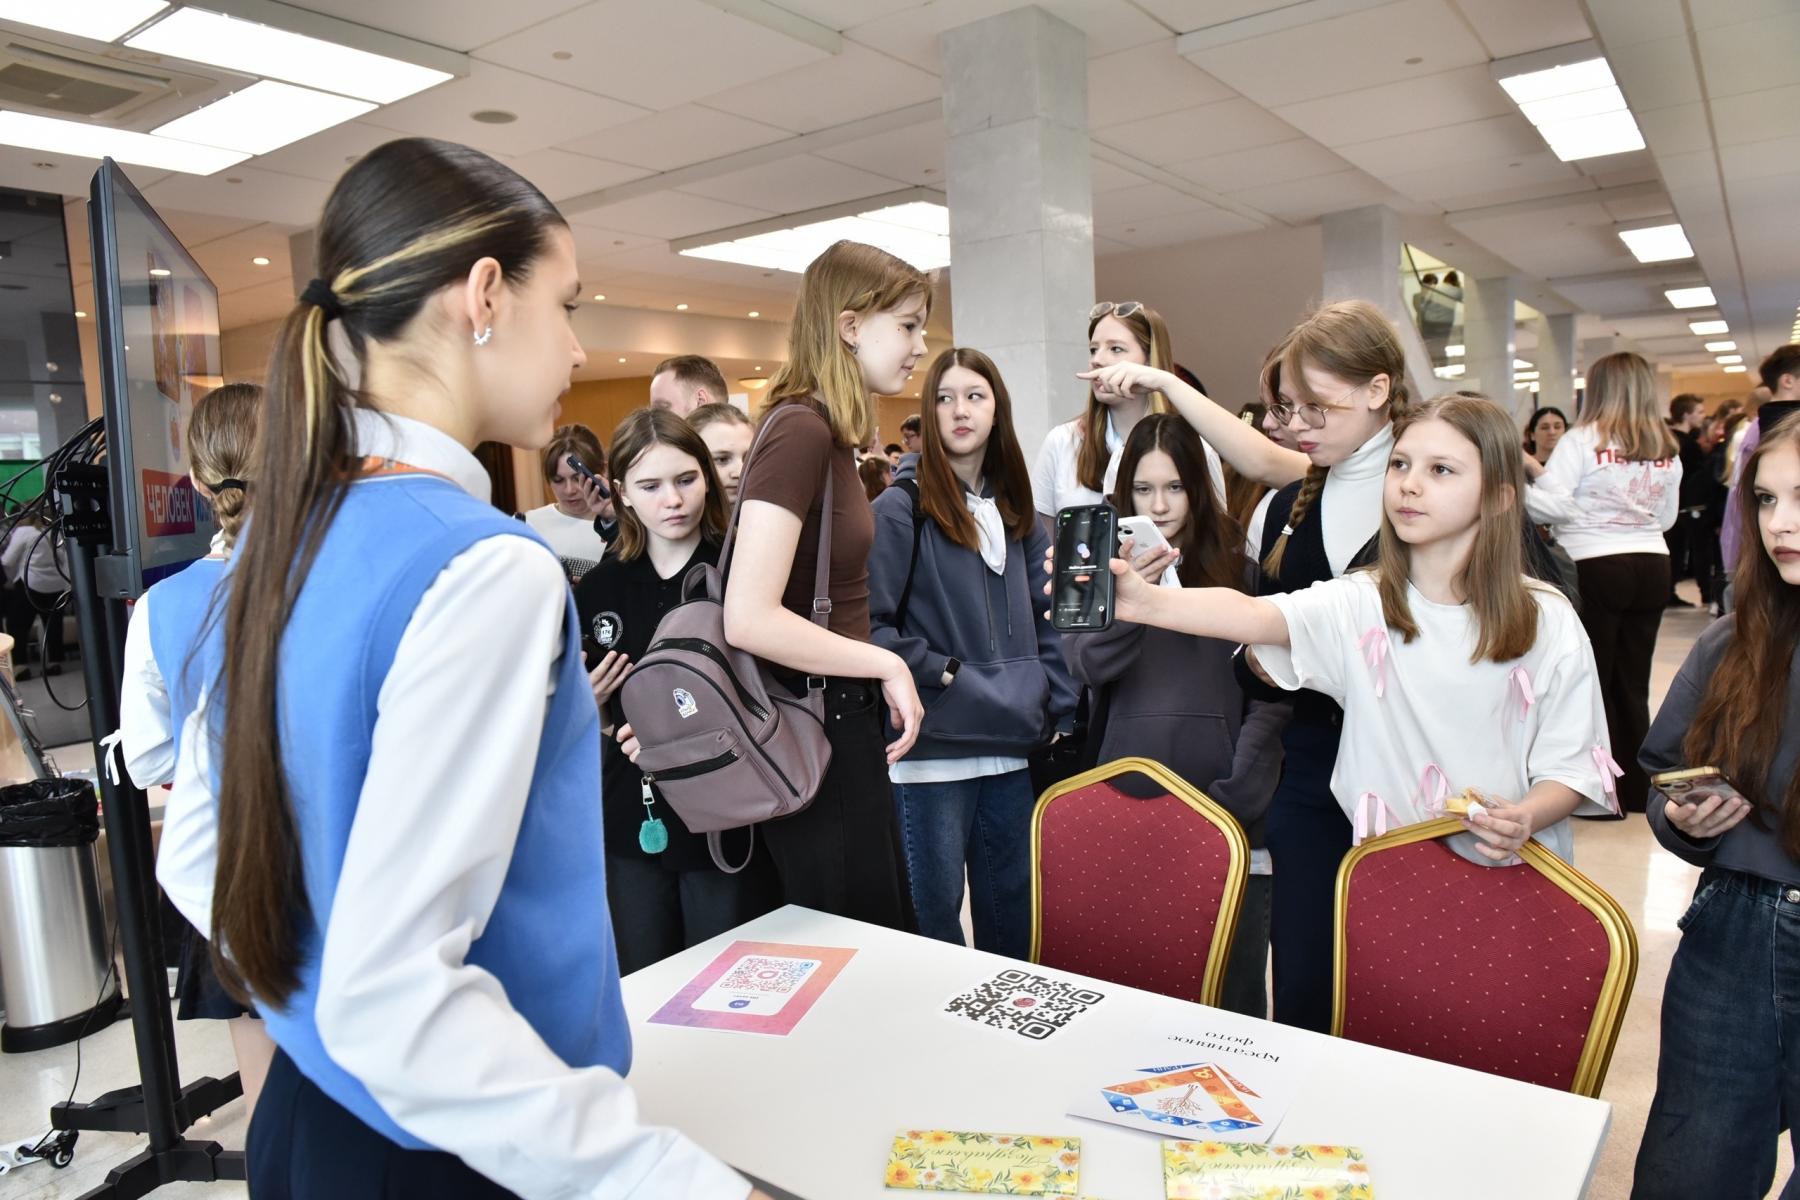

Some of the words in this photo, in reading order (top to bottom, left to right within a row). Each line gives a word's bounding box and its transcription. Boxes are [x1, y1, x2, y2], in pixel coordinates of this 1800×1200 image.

[146, 484, 192, 524] ЧЕЛОВЕК
[1167, 1035, 1280, 1063] Креативное
[1205, 1031, 1254, 1046] фото
